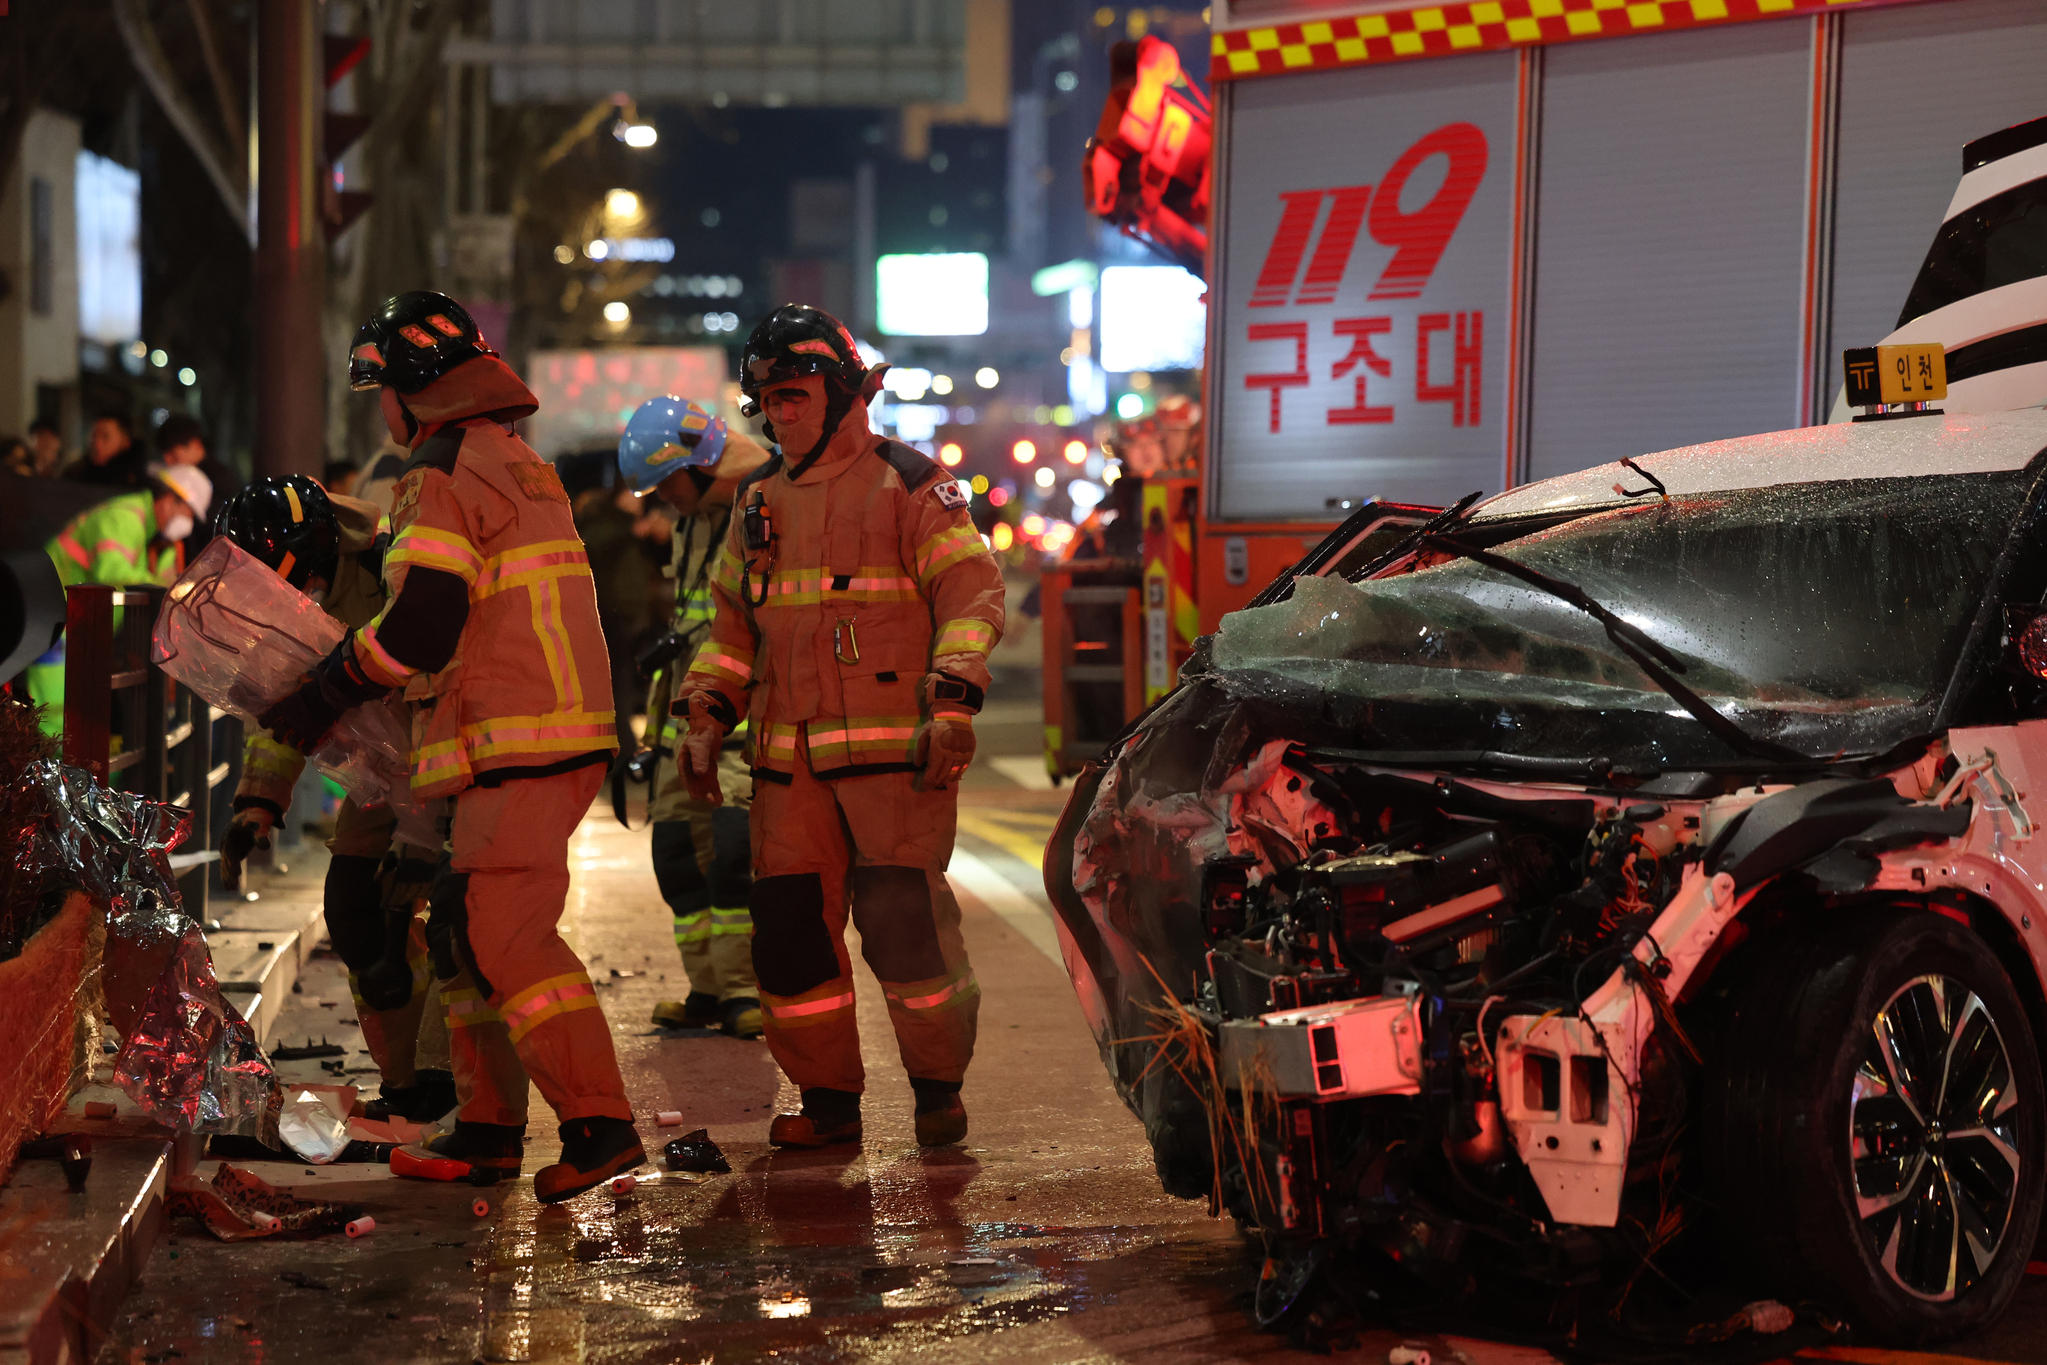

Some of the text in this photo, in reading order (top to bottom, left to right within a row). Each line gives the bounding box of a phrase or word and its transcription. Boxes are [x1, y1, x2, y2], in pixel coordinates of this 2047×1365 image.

[1248, 122, 1488, 307] 119
[1246, 311, 1482, 433] 구조대
[1896, 353, 1933, 392] 인천
